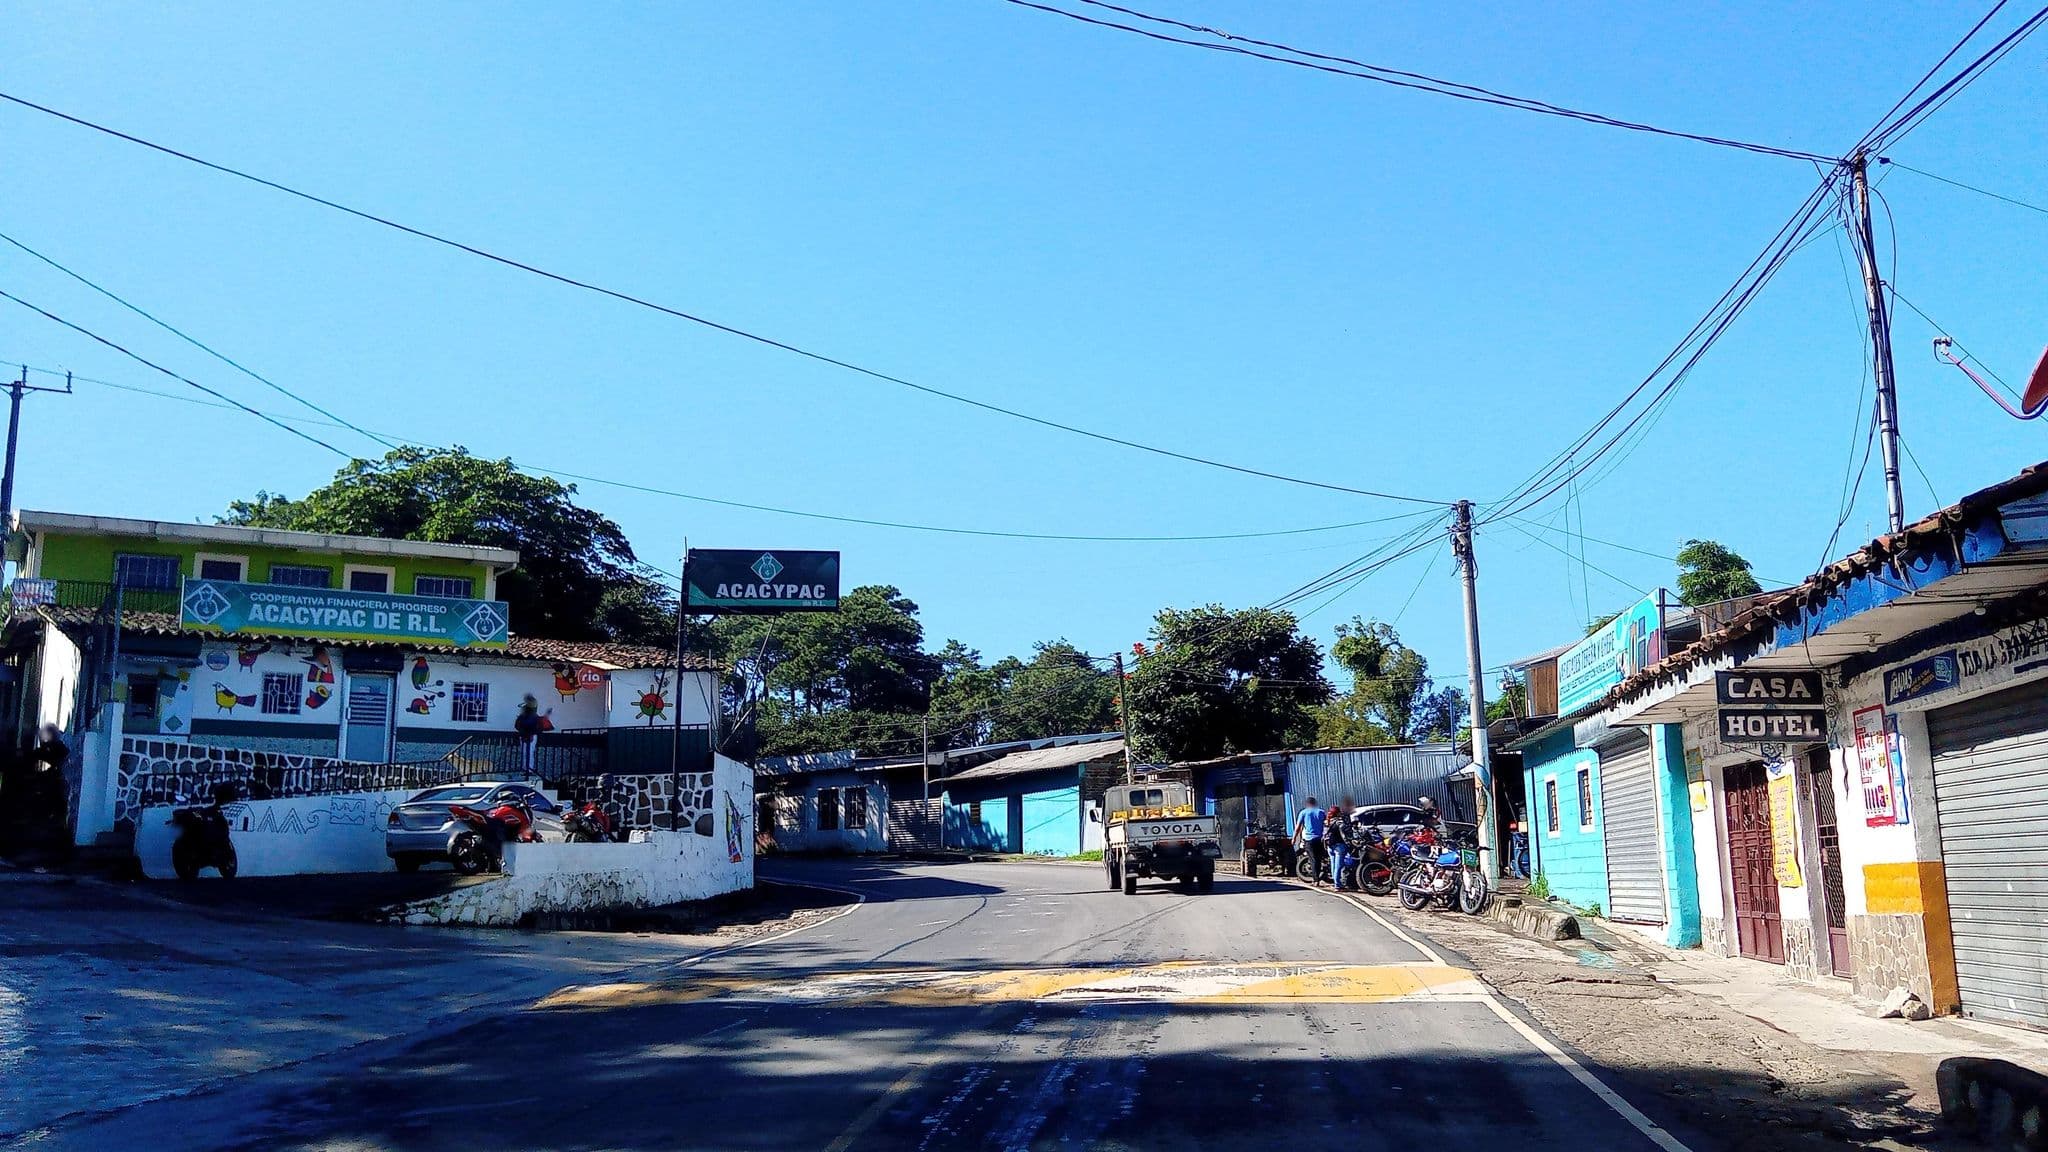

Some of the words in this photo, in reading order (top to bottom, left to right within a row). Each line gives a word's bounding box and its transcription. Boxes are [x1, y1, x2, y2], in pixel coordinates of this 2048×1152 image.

[716, 583, 826, 599] ACACYPAC
[250, 592, 325, 606] COOPERATIVA
[327, 597, 389, 610] FINANCIERA
[391, 602, 447, 614] PROGRESO
[248, 603, 366, 628] ACACYPAC
[373, 611, 401, 630] DE
[408, 613, 447, 633] R.L.
[582, 670, 600, 682] ria
[1728, 678, 1812, 698] CASA
[1726, 715, 1820, 737] HOTEL
[1141, 823, 1203, 835] TOYOTA
